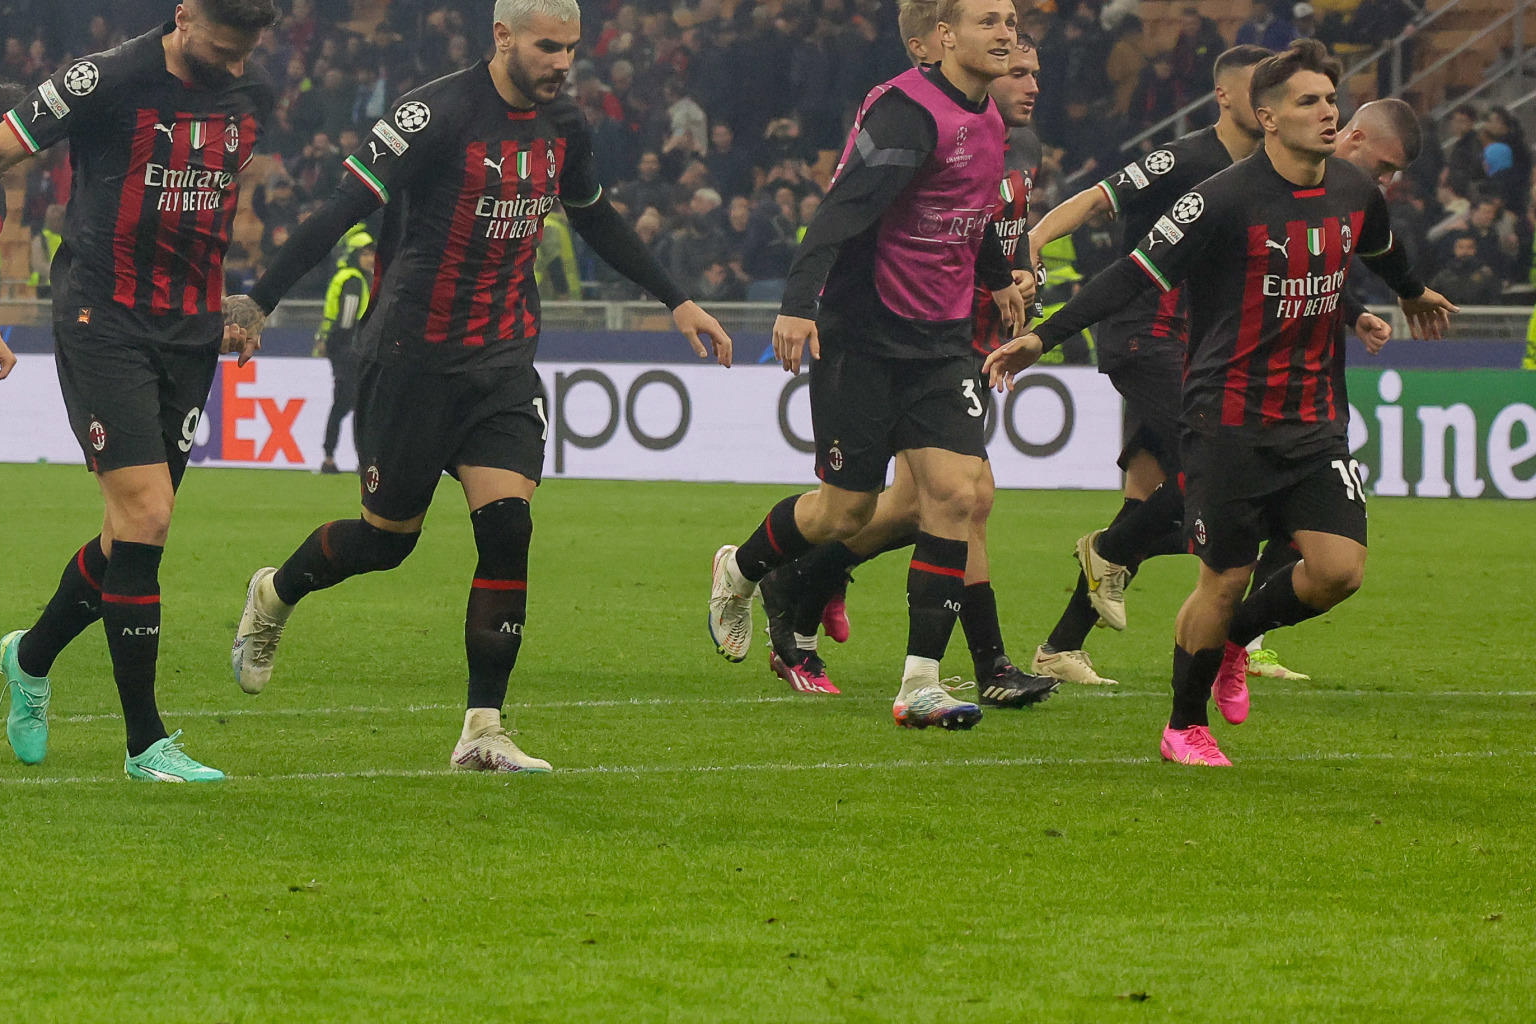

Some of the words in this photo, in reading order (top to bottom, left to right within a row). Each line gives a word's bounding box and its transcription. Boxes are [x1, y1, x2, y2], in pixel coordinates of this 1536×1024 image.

[157, 191, 180, 212] FLY
[182, 190, 221, 212] BETTER
[485, 219, 510, 240] FLY
[1276, 299, 1302, 319] FLY
[1302, 292, 1340, 317] BETTER
[178, 406, 200, 453] 9
[122, 625, 160, 637] ACM
